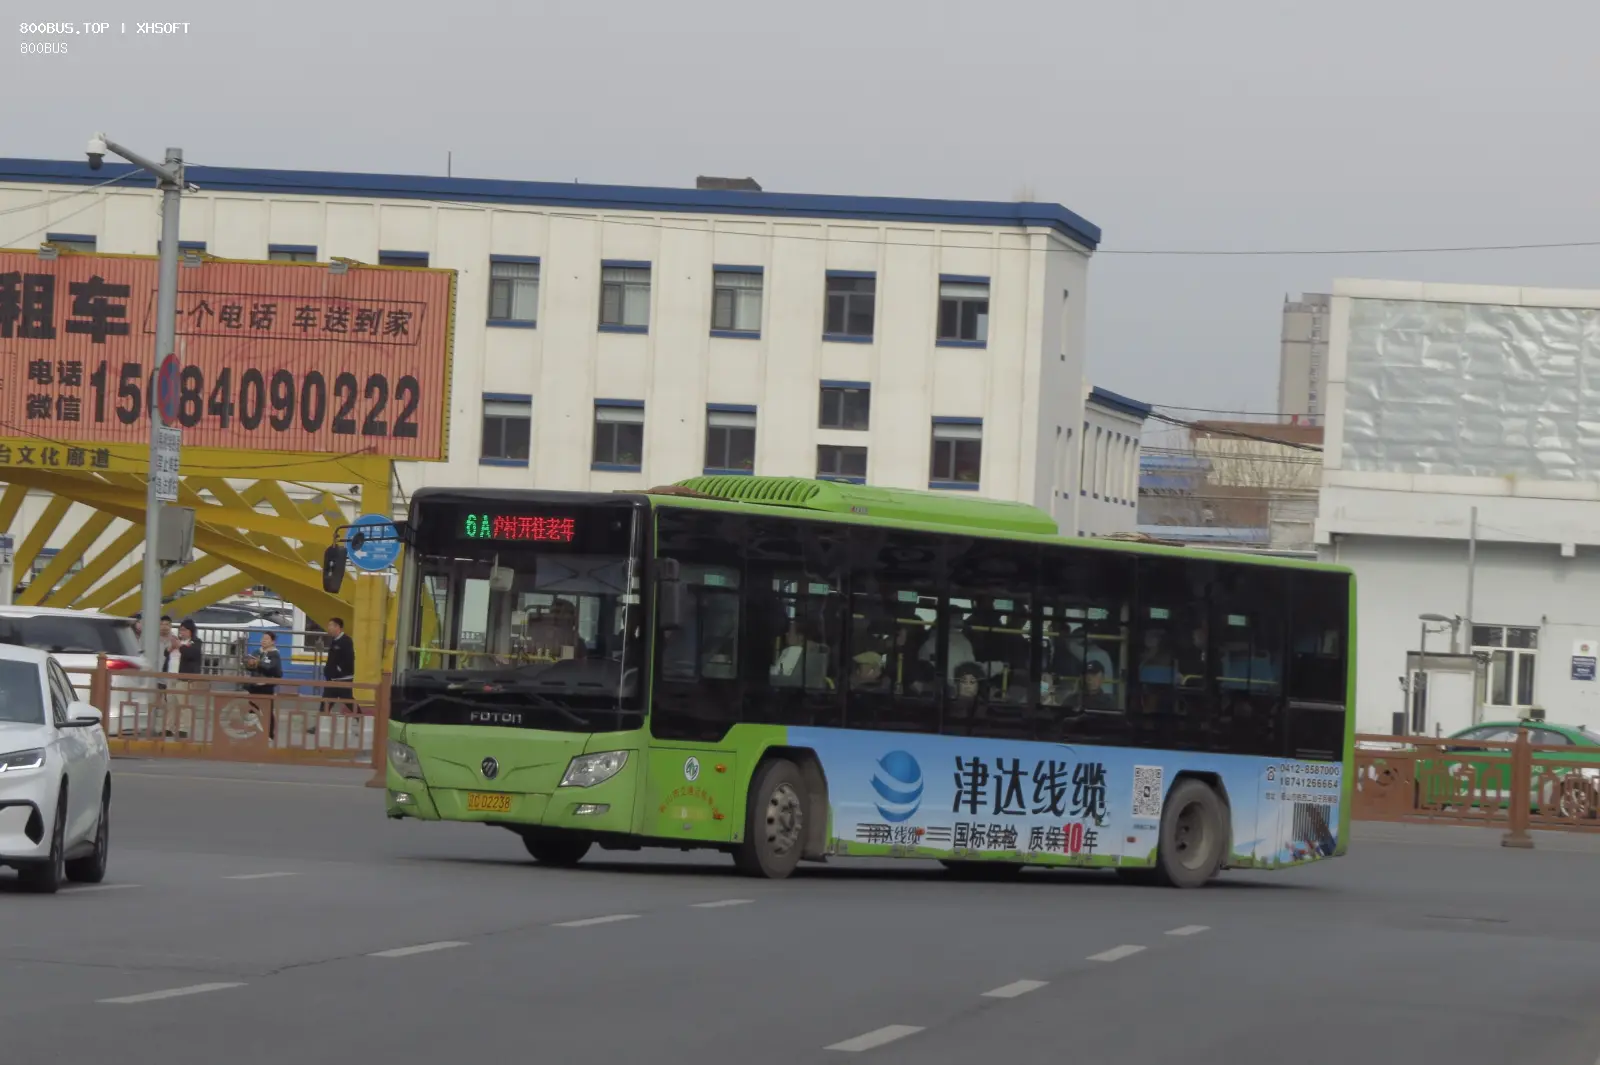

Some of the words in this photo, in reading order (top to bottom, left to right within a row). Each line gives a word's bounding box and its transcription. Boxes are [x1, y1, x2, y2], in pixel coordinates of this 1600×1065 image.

[176, 299, 277, 331] 个电话
[291, 304, 413, 338] 车送到家
[28, 358, 83, 387] 电话
[26, 393, 82, 422] 微信
[465, 513, 491, 538] 6A
[470, 711, 522, 724] FOTON
[952, 755, 1108, 818] 津达线缆
[1028, 822, 1099, 854] 质保10年
